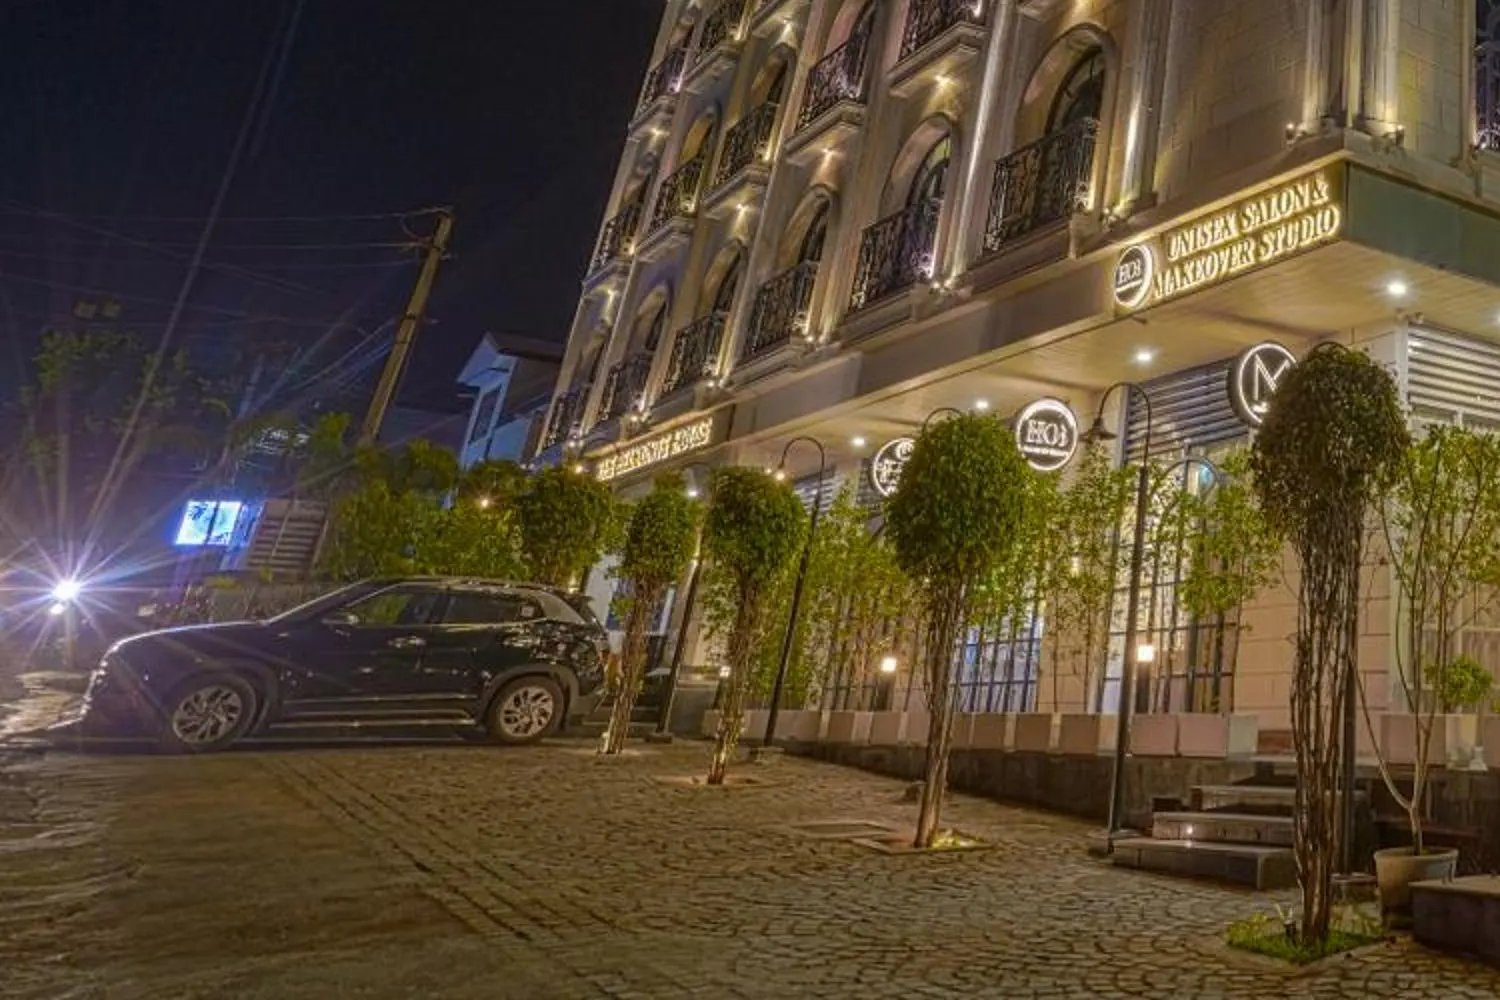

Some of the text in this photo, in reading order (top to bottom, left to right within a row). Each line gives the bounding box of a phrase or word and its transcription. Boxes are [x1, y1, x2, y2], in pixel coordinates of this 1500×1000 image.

[1153, 204, 1342, 299] MAKEOVER STUDIO
[1167, 172, 1330, 262] UNISEX SALON &
